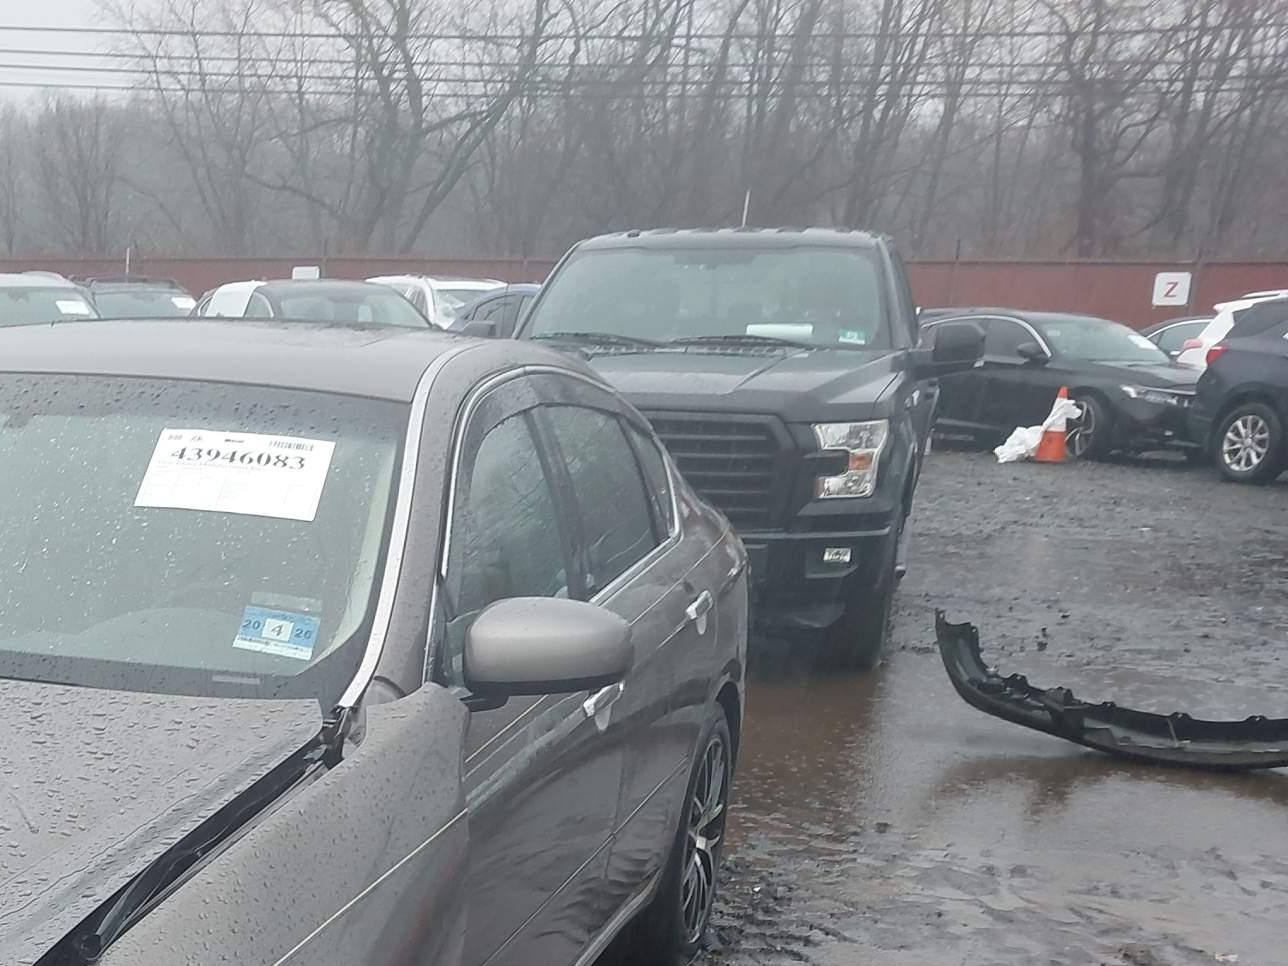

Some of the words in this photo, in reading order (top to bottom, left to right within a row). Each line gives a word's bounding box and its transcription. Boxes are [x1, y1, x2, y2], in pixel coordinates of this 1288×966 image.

[1163, 281, 1179, 298] Z
[171, 447, 306, 470] 43946083
[242, 619, 261, 630] 20
[270, 624, 284, 637] 4
